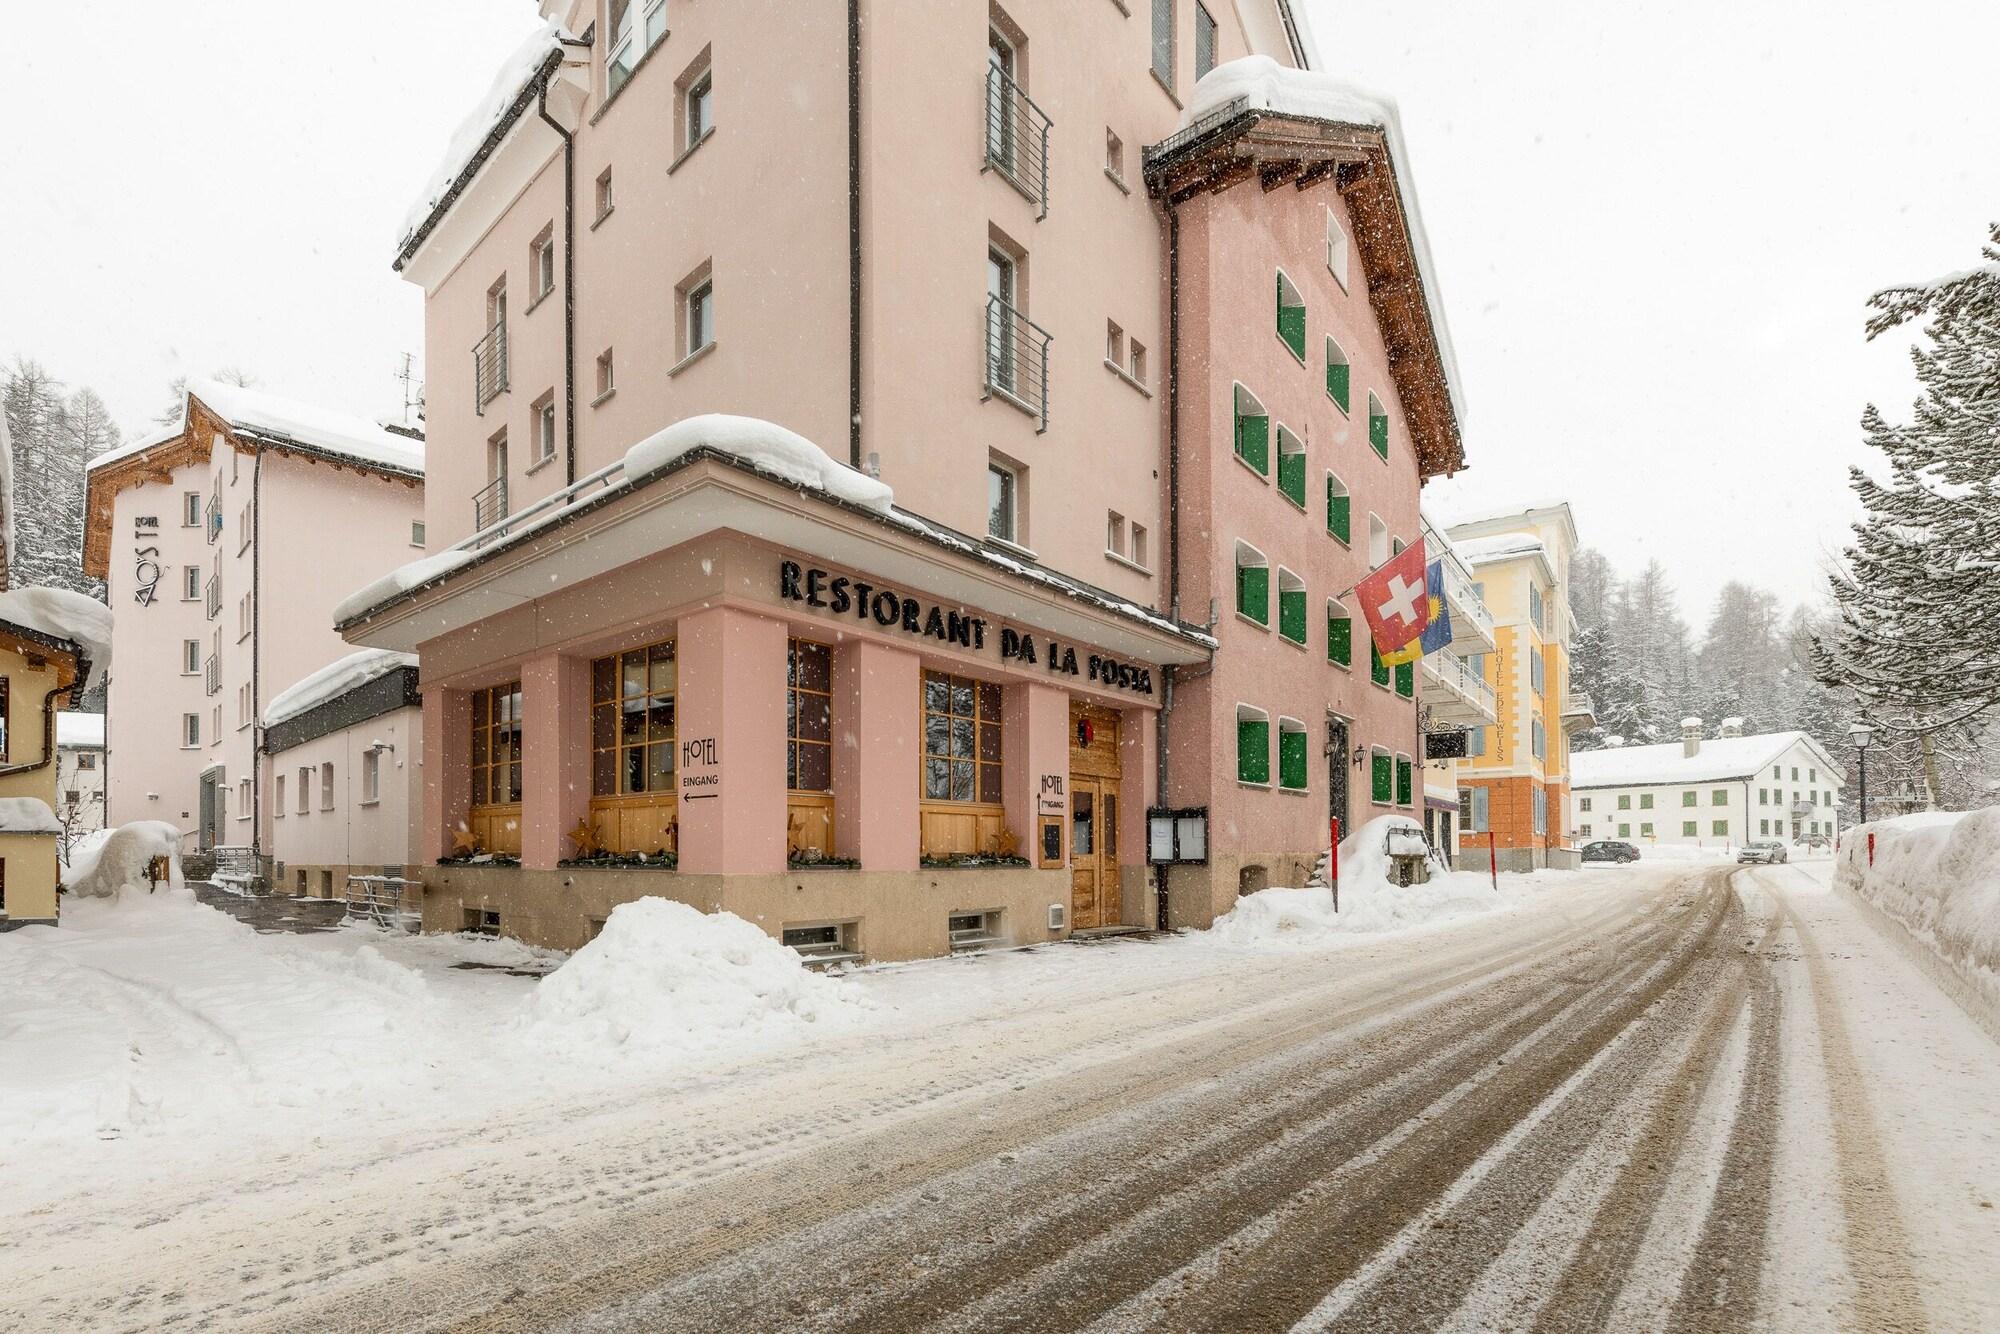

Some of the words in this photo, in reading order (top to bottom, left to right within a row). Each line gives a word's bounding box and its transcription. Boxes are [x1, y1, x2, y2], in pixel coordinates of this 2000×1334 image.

[781, 560, 987, 650] RESTORANT
[1001, 628, 1038, 664] DA
[1049, 642, 1080, 676] LA
[1088, 654, 1153, 695] POSTA
[1495, 647, 1504, 687] HOTEL
[1496, 691, 1505, 762] EDELWEISS
[682, 737, 719, 768] HOTEL
[683, 774, 719, 787] EINGANG
[1041, 774, 1064, 795] HOTEL
